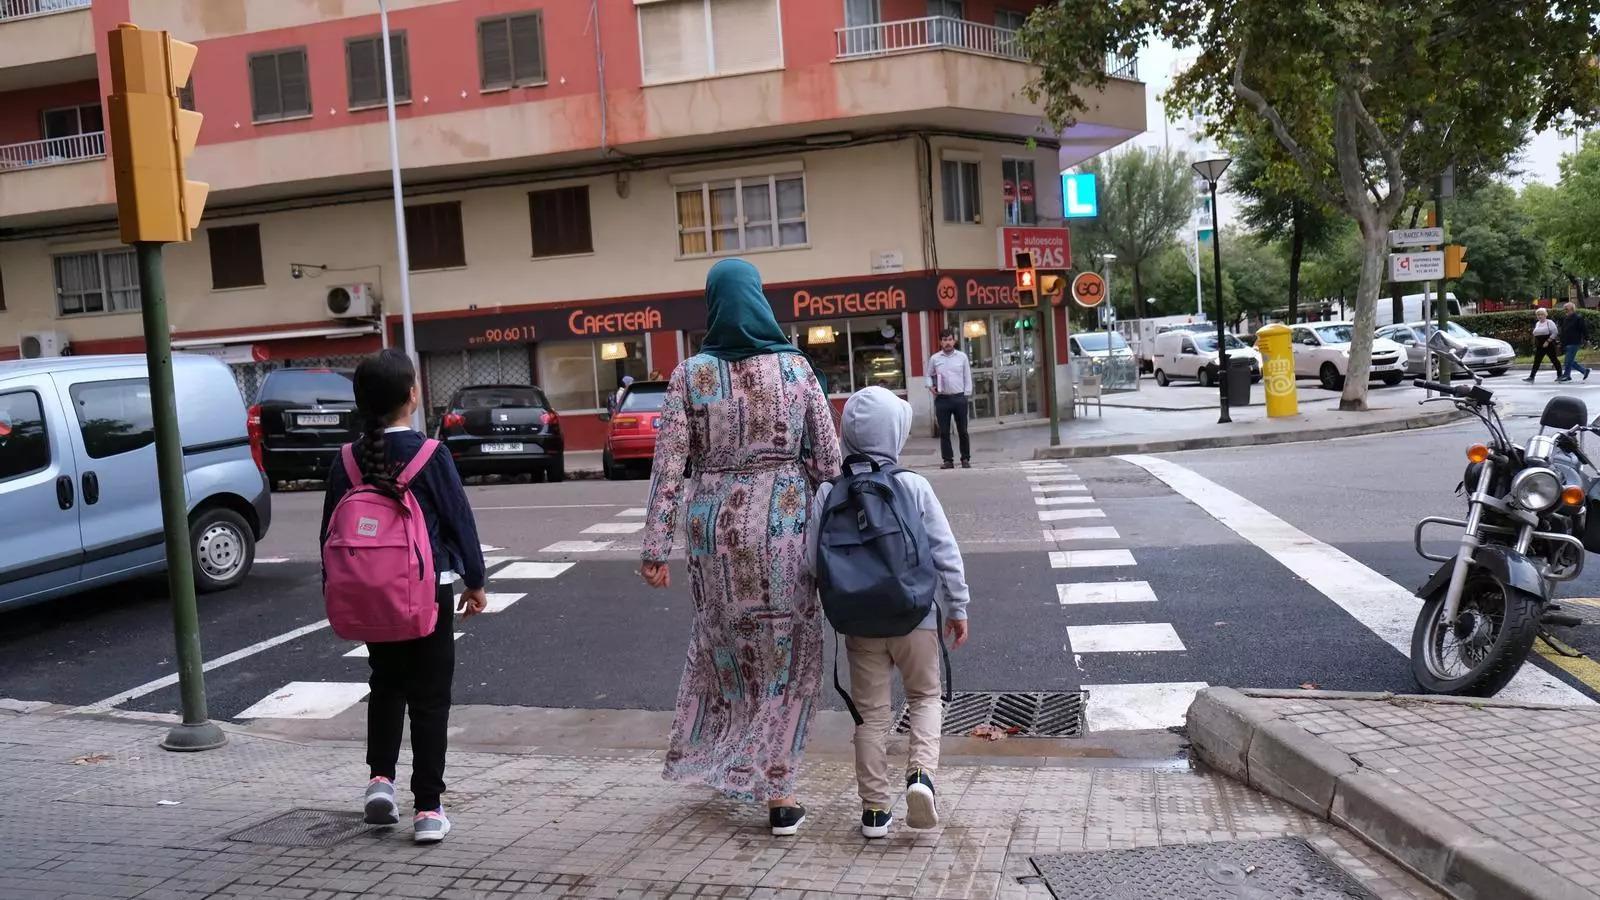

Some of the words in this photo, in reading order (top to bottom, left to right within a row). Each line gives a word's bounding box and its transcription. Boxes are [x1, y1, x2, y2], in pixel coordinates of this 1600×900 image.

[1067, 177, 1093, 214] L
[1024, 236, 1063, 246] autoescola
[1011, 247, 1065, 267] RBAS
[966, 278, 1019, 305] PASTELE
[569, 306, 662, 335] CAFETERÍA
[486, 328, 502, 342] 90
[504, 327, 520, 341] 60
[522, 326, 536, 339] 11
